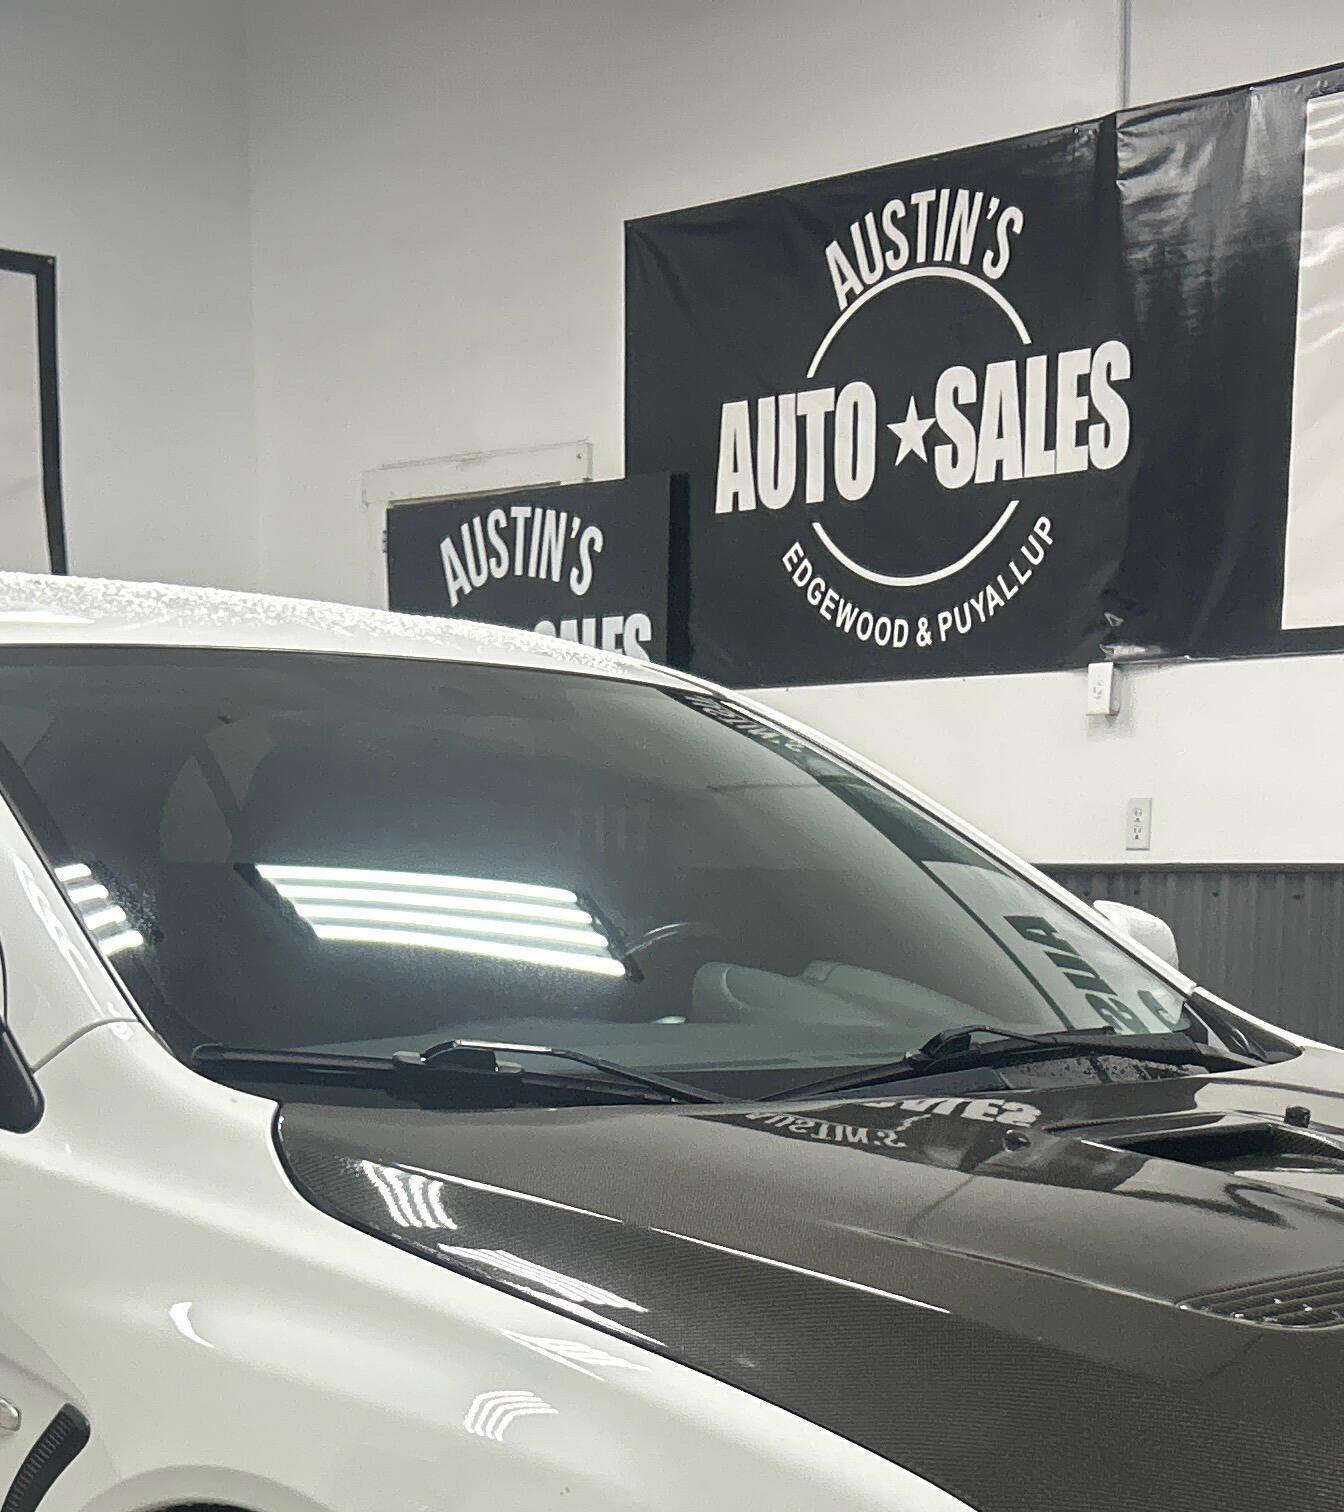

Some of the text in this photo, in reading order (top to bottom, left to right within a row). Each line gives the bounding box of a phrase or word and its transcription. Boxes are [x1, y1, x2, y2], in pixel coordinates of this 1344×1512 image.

[825, 188, 1023, 308] AUSTIN'S
[715, 340, 1132, 514] AUTO SALES
[440, 505, 604, 608] AUSTIN'S
[782, 516, 1054, 648] EDGEWOOD & PUYALLUP
